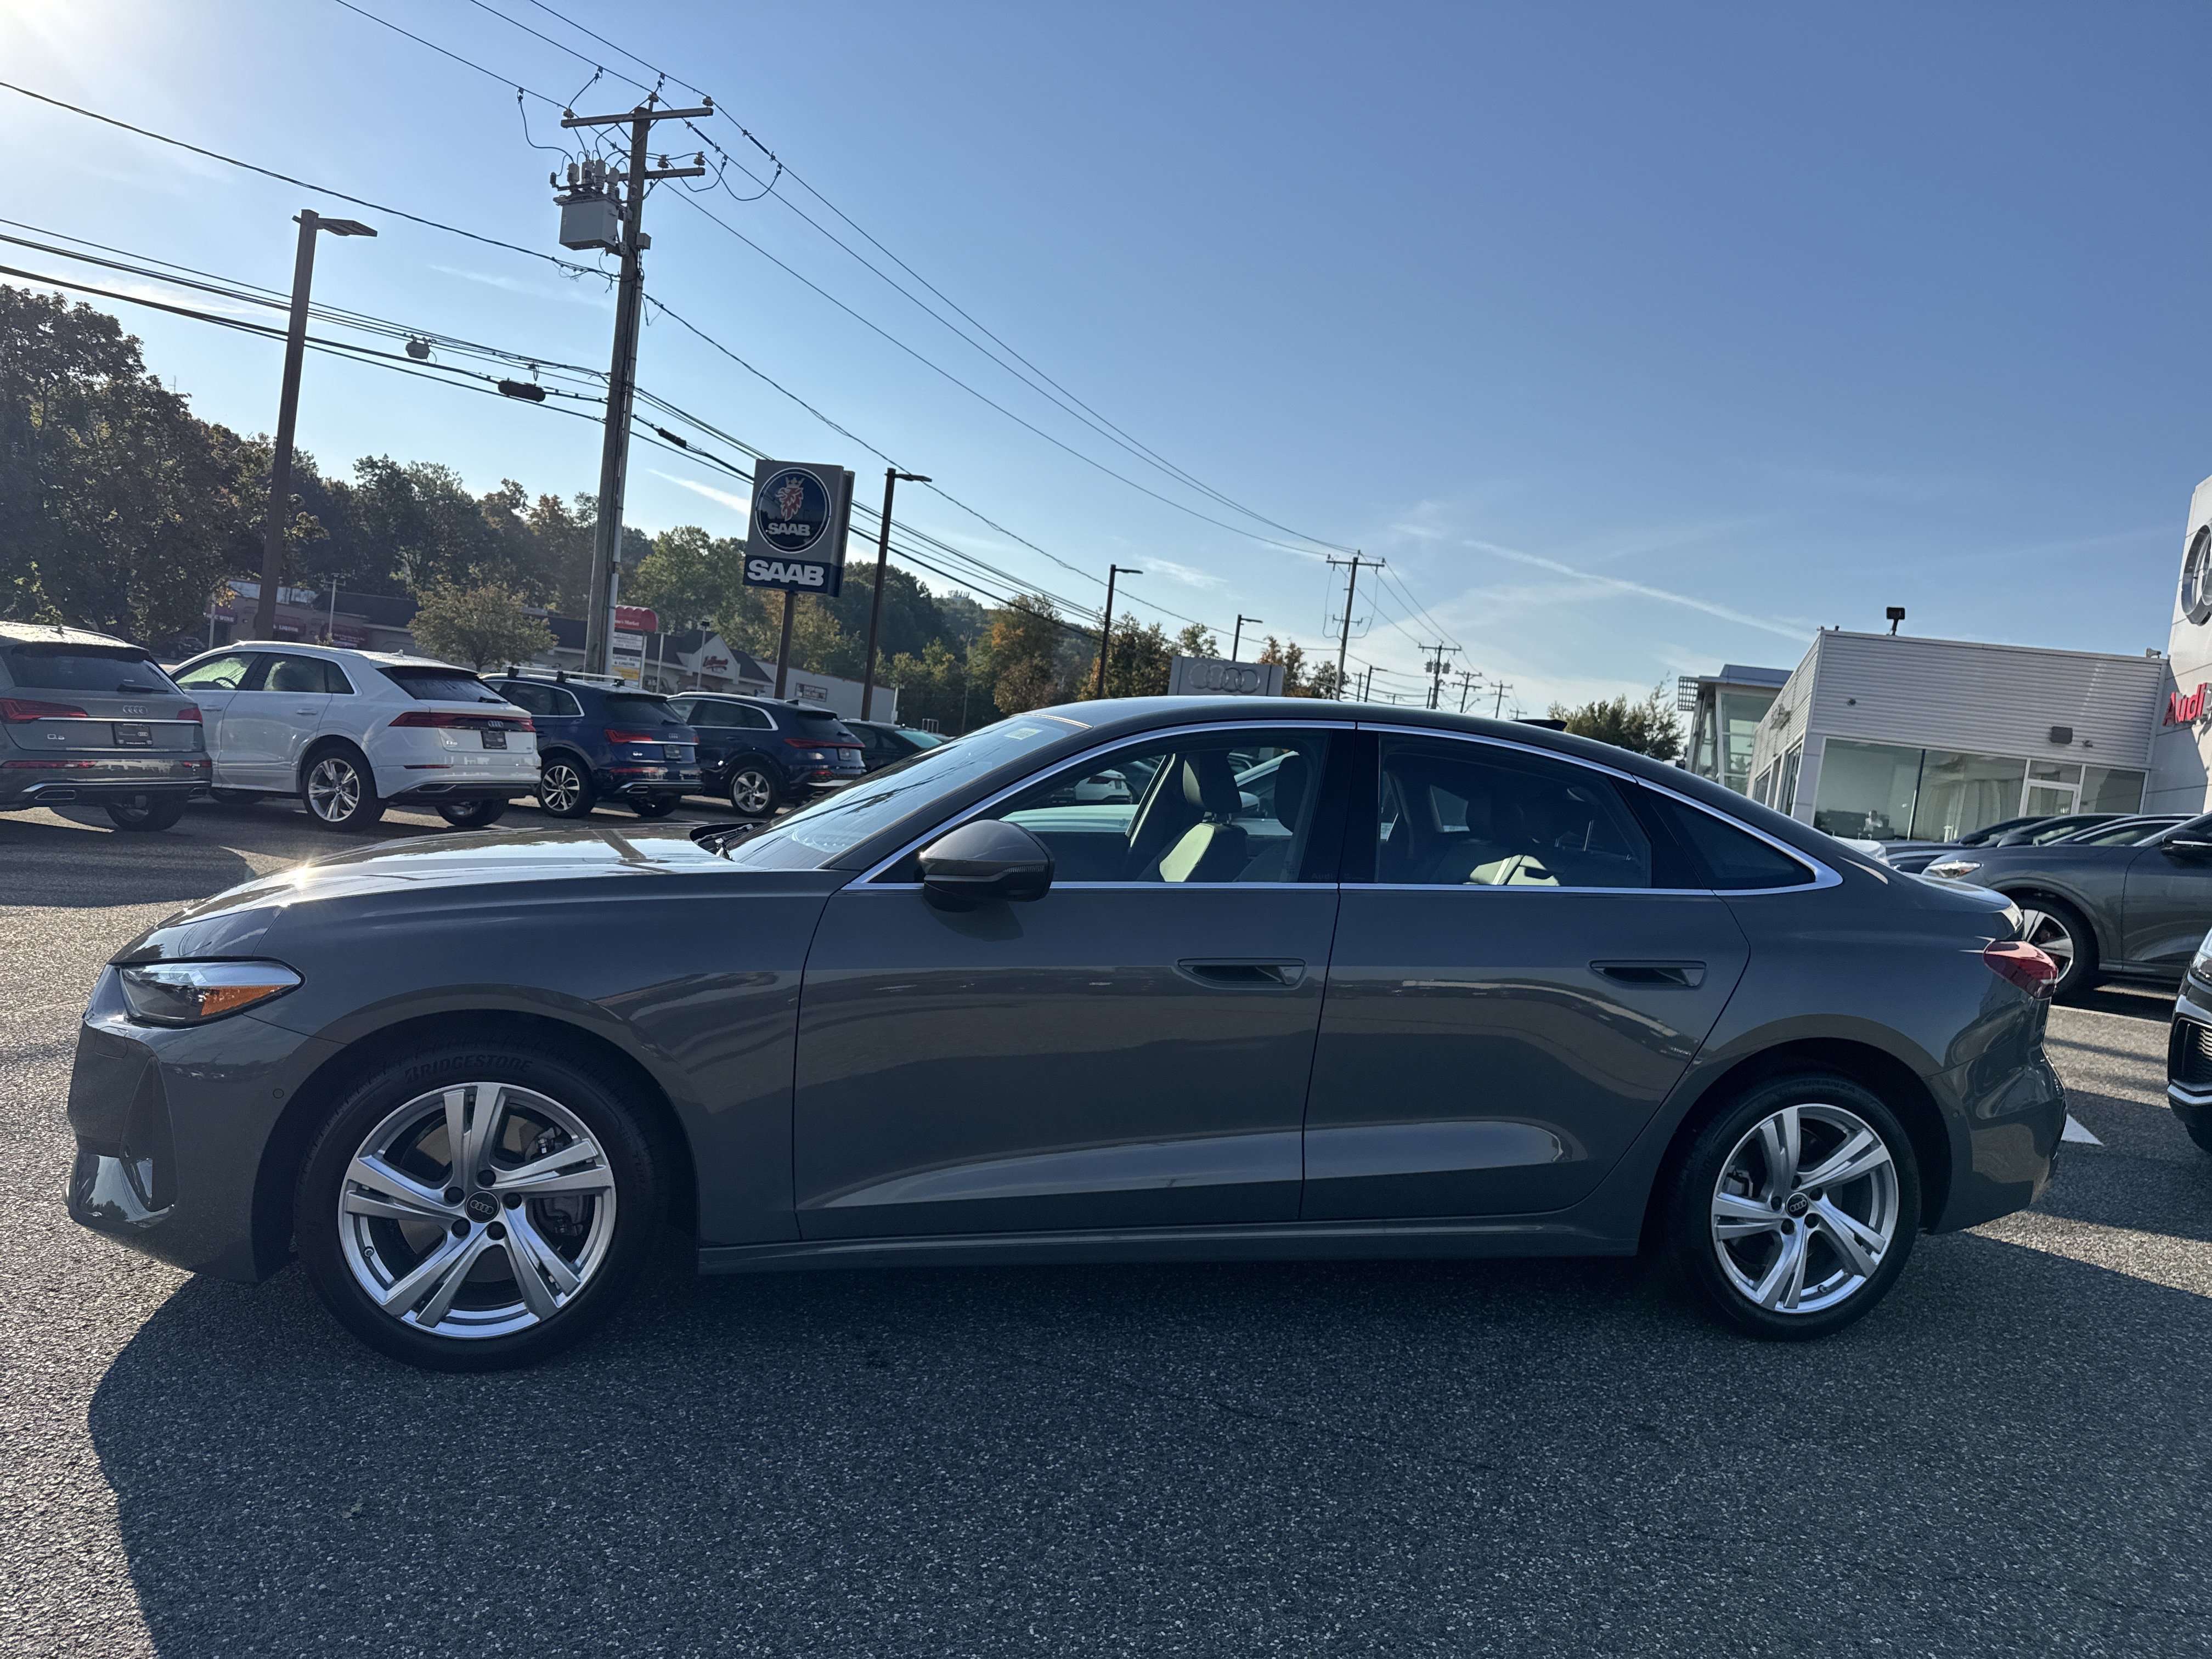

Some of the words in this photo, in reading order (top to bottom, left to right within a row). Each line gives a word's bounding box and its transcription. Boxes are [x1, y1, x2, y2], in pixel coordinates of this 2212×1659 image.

[768, 522, 810, 536] SAAB
[747, 559, 824, 586] SAAB
[2163, 682, 2207, 727] Audi
[404, 1054, 533, 1084] BRIDGESTONE
